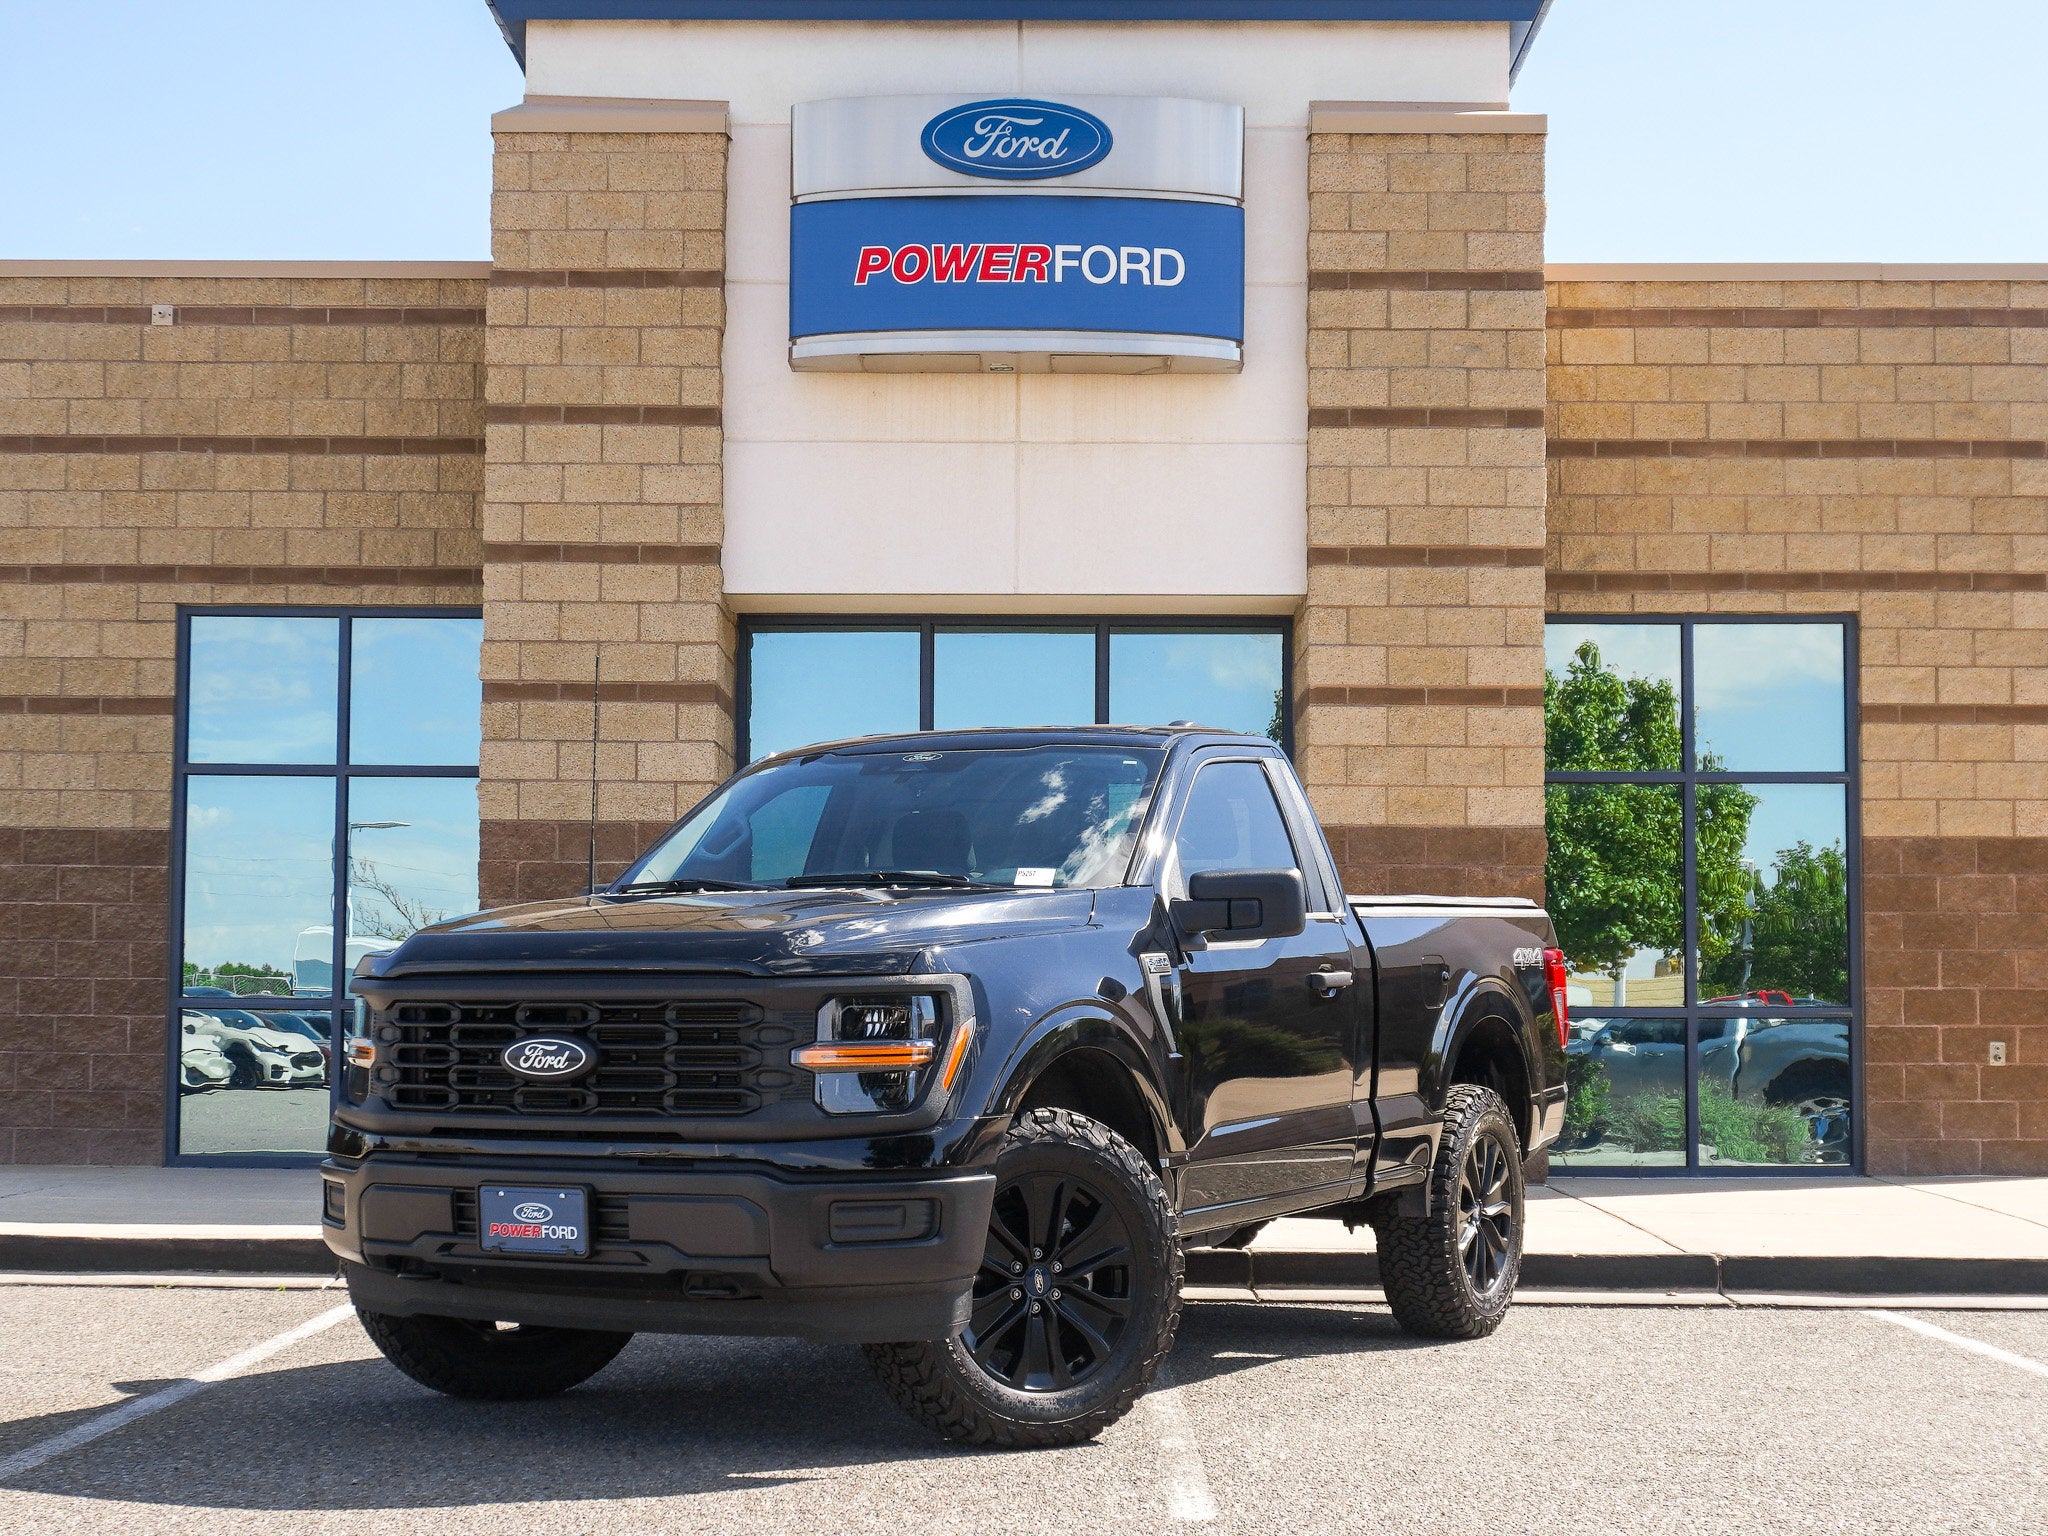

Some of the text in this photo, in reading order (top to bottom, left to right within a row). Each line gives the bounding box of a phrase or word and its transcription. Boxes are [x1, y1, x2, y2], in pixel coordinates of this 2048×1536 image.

[963, 115, 1069, 159] Ford
[854, 243, 1186, 287] POWERFORD
[519, 1043, 570, 1069] Ford
[520, 1206, 546, 1219] Ford
[489, 1222, 578, 1240] POWERFORD
